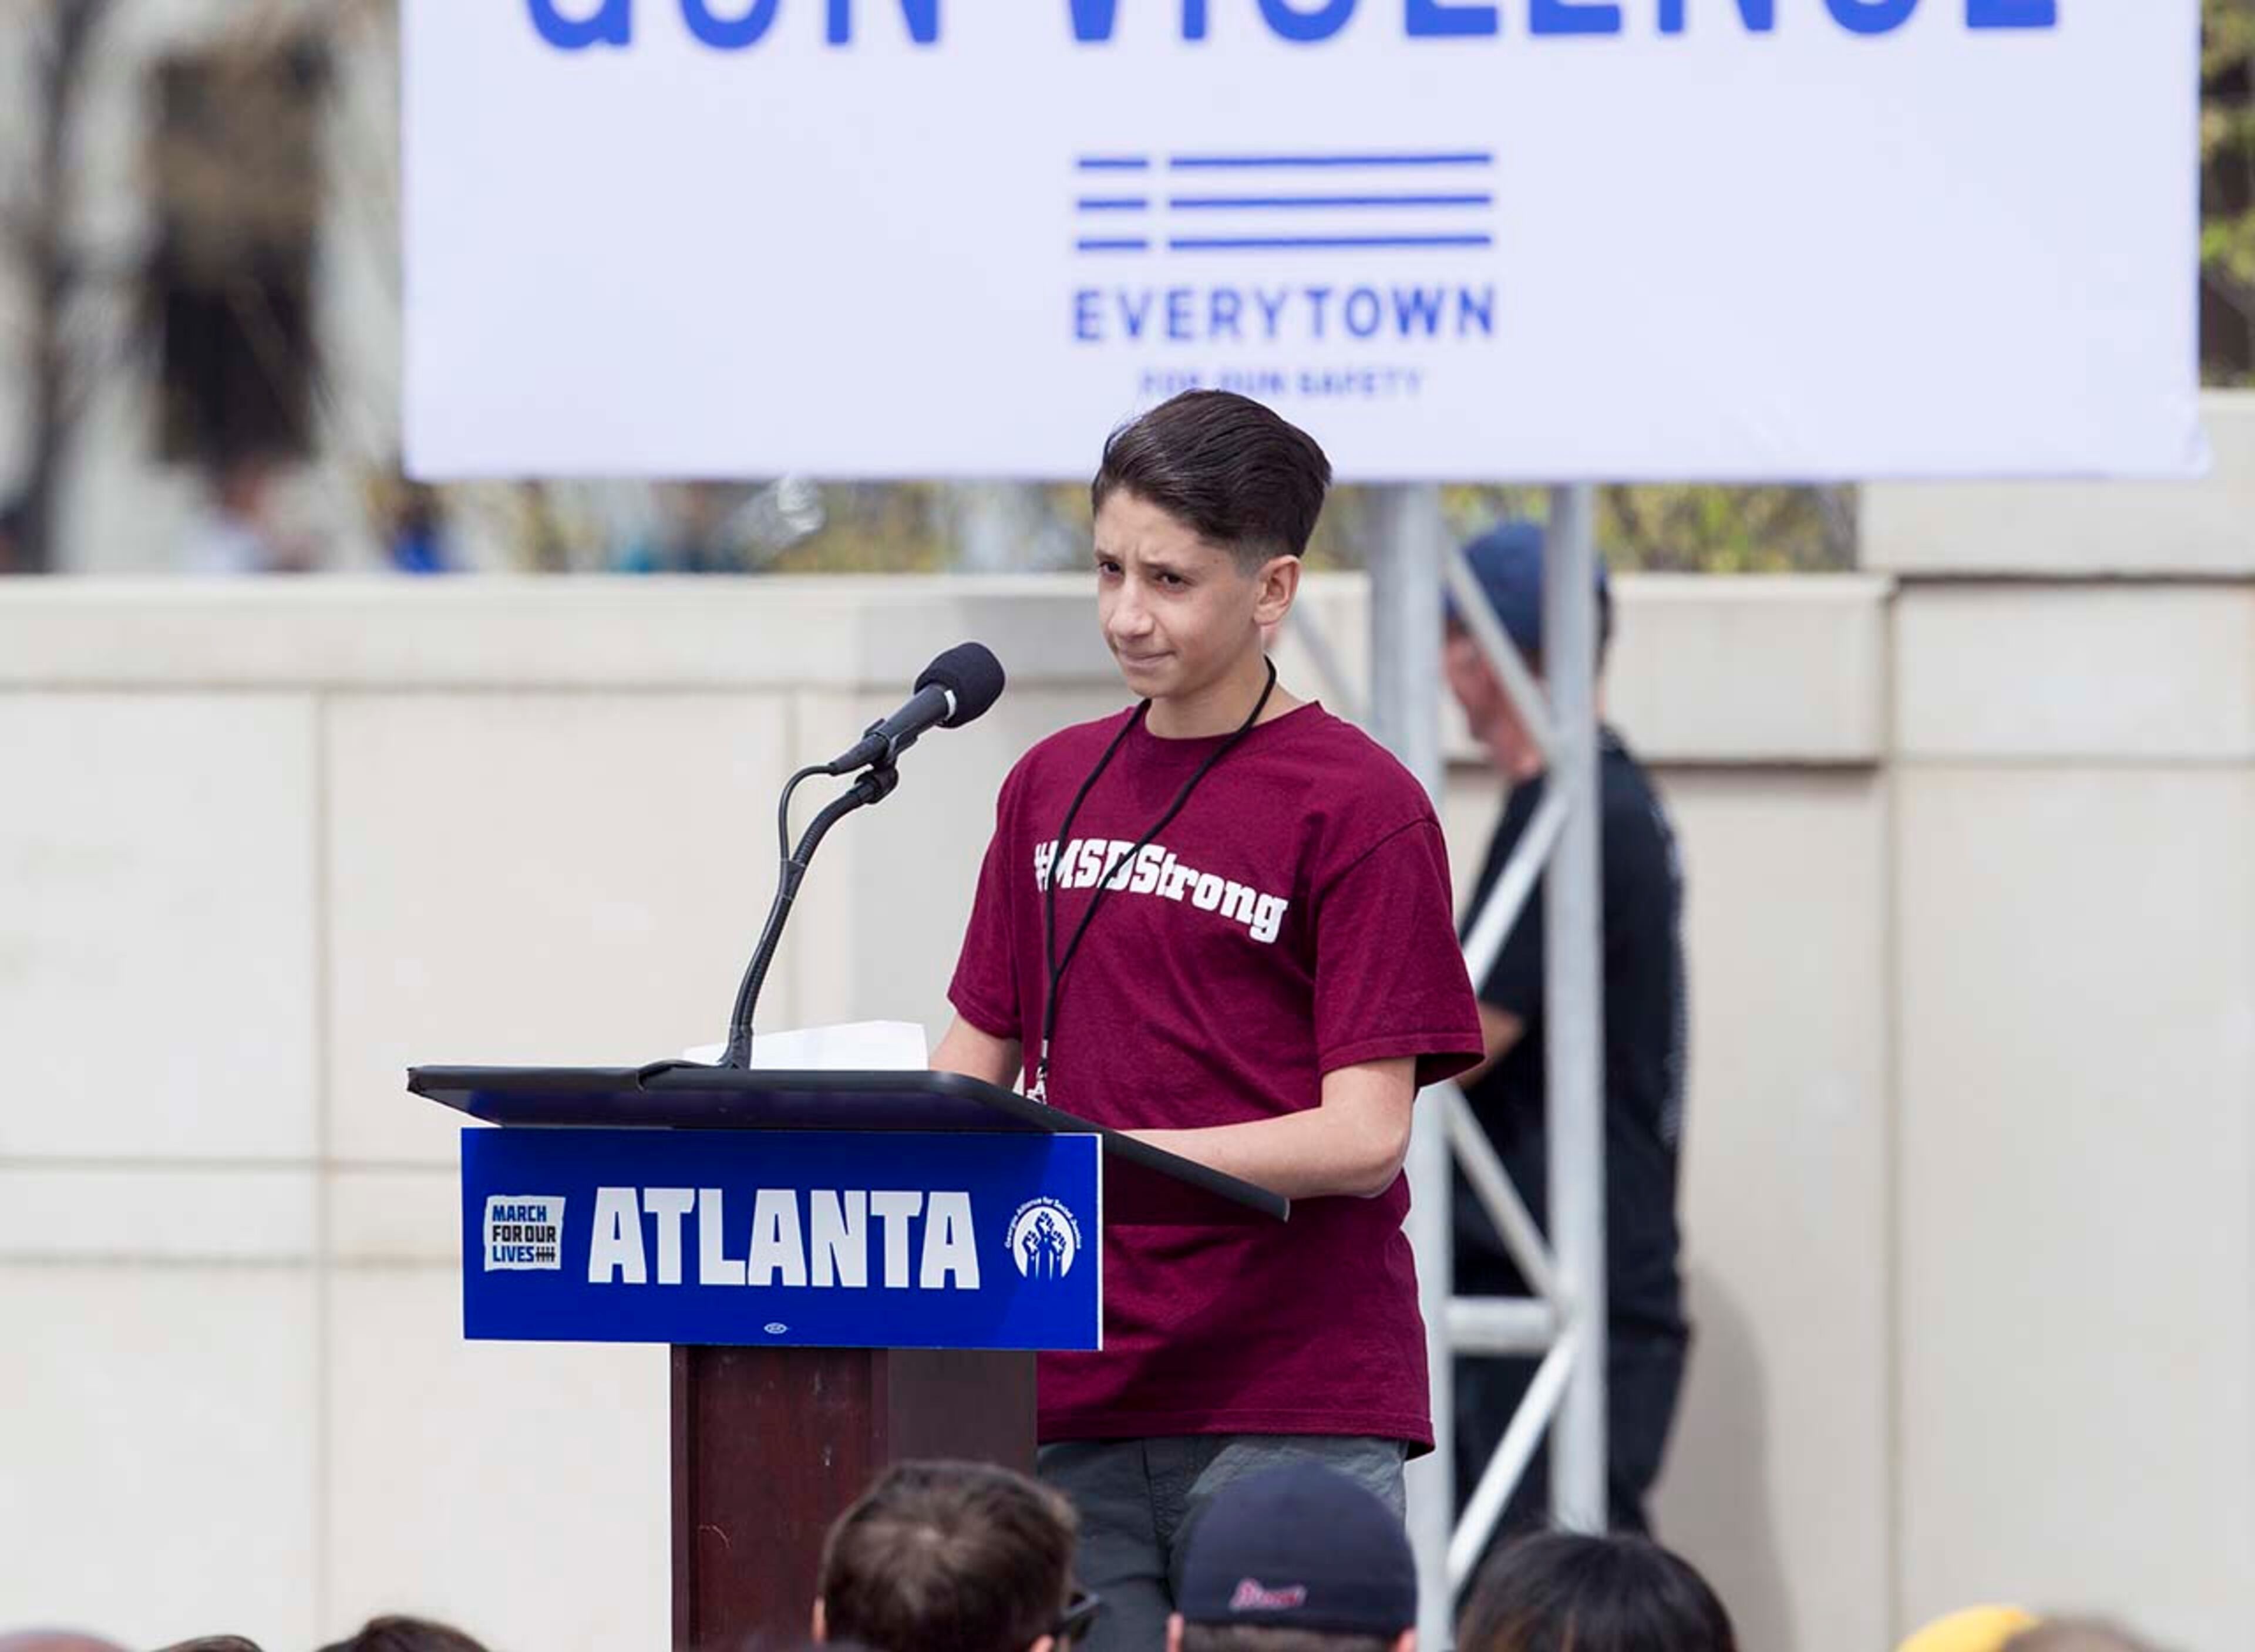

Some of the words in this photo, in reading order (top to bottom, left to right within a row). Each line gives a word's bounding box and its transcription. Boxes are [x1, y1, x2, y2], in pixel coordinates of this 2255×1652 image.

[1074, 286, 1493, 340] EVERYTOWN
[493, 1205, 547, 1222] MARCH
[493, 1225, 522, 1242] FOR
[525, 1225, 556, 1242] OUR
[588, 1187, 980, 1289] ATLANTA
[493, 1245, 534, 1262] LIVES
